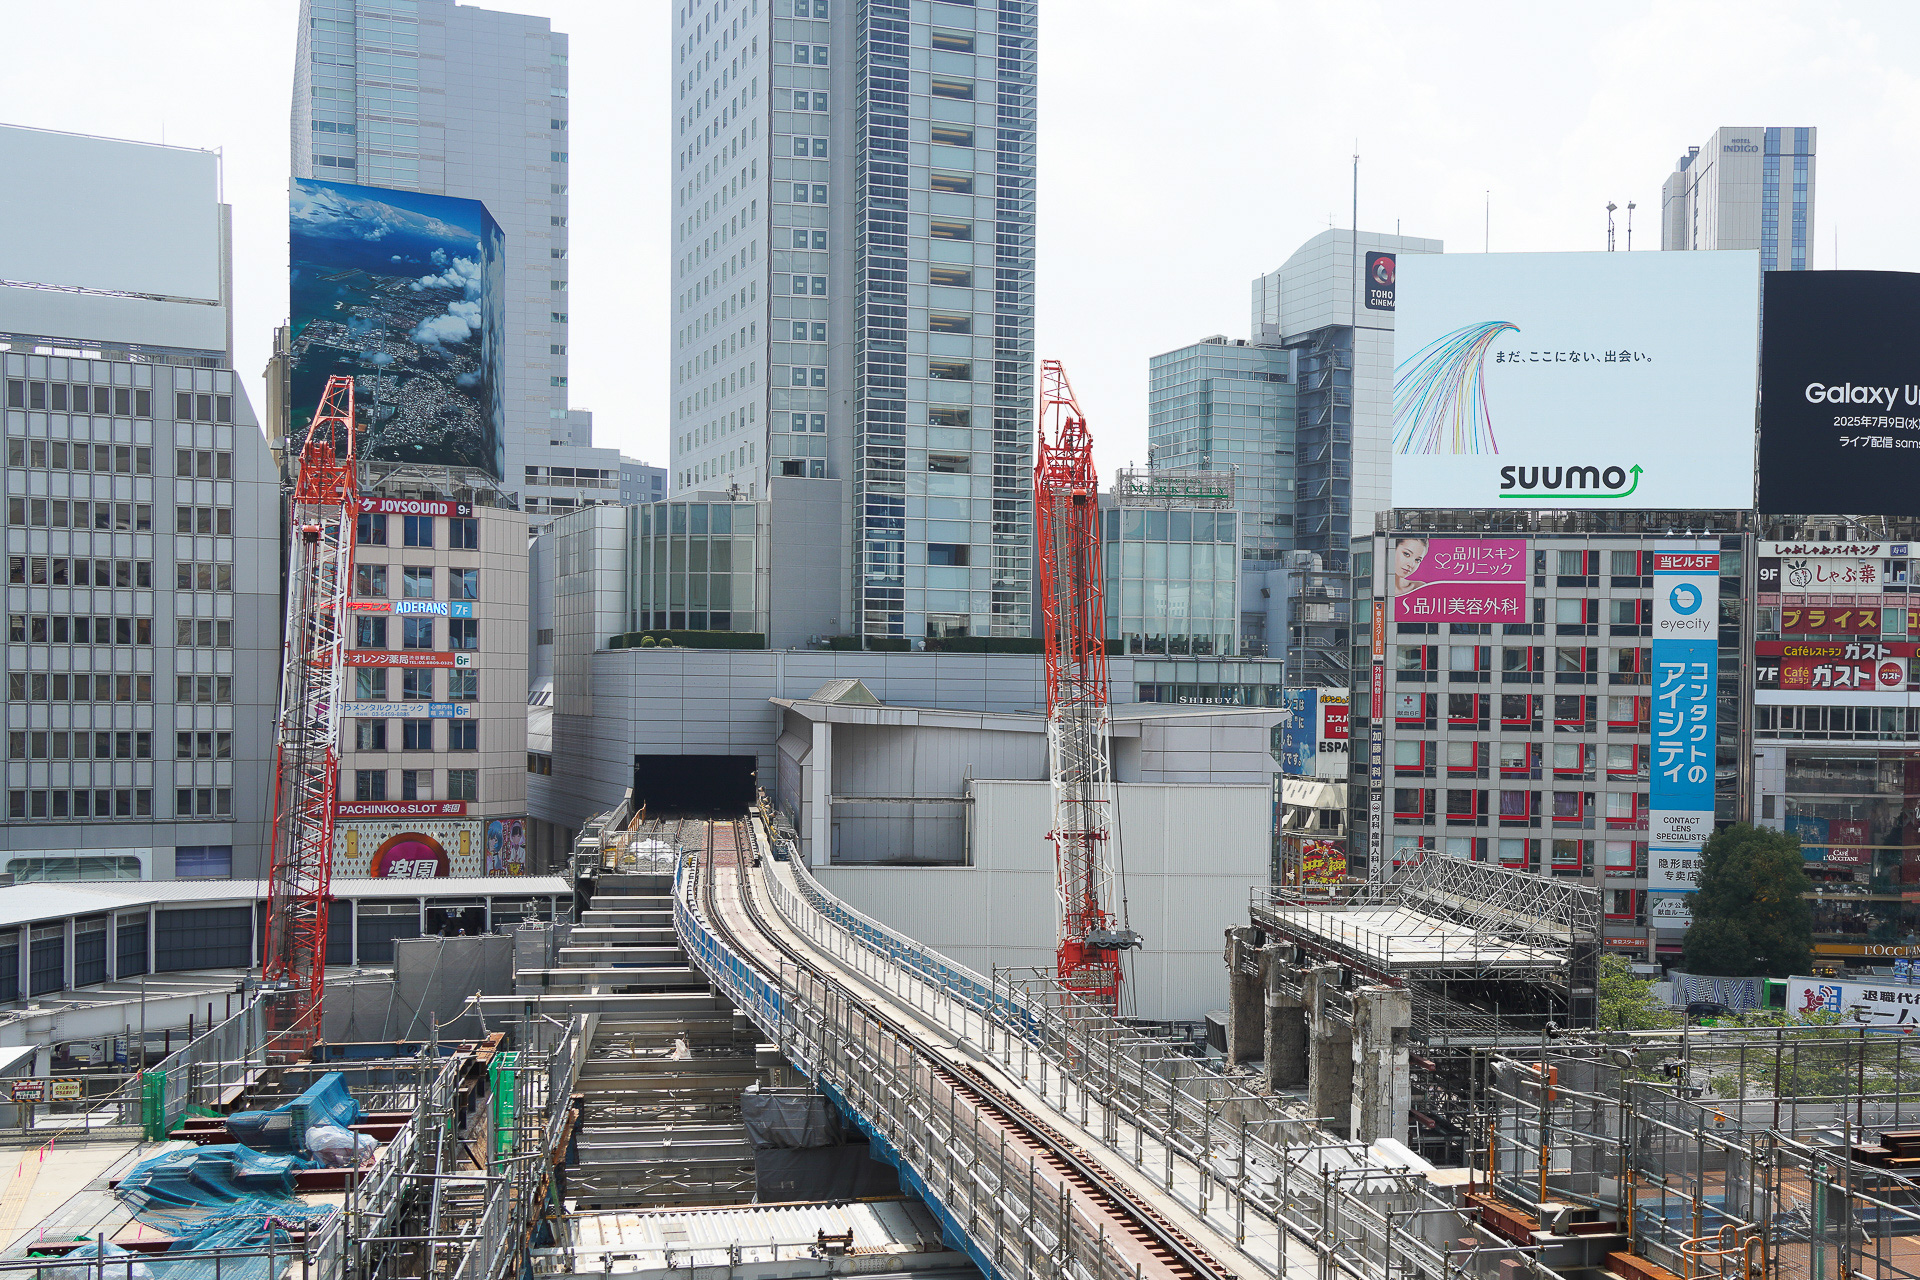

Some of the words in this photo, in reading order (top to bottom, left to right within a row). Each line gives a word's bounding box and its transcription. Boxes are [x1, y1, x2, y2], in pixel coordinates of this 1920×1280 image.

[1723, 145, 1759, 153] INDIGO
[1371, 290, 1393, 299] TOHO
[1496, 350, 1653, 363] まだ、ここにない、出会い。
[1805, 382, 1899, 411] Galaxy
[1904, 384, 1920, 405] U
[1839, 435, 1893, 448] ライブ配信
[1500, 465, 1626, 489] suumo
[1131, 485, 1179, 494] MARK
[1186, 486, 1226, 495] CITY
[380, 500, 448, 515] JOYSOUND
[457, 504, 470, 515] 9F
[1453, 546, 1520, 560] 品川スキン
[1774, 543, 1880, 556] しゃぶしゃぶバイキング
[1453, 562, 1512, 575] クリニック
[1660, 556, 1713, 568] 当ビル5F
[1759, 568, 1779, 581] 9F
[1816, 564, 1876, 584] しゃぶ葉
[395, 601, 448, 616] ADERANS
[455, 604, 469, 615] 7F
[1413, 597, 1519, 616] 品川美容外科
[1660, 618, 1711, 632] eyecity
[1782, 609, 1877, 629] プライス
[1907, 611, 1920, 628] コ
[1844, 642, 1891, 661] ガスト
[352, 653, 409, 664] オレンジ薬局
[456, 655, 470, 666] 6F
[1756, 667, 1779, 681] 7F
[1783, 666, 1809, 678] Café
[1812, 664, 1871, 687] ガスト
[1881, 672, 1901, 680] ガスト
[1784, 677, 1809, 685] レストラン
[1179, 695, 1240, 704] SHIBUYA
[455, 705, 469, 716] 6F
[1658, 662, 1686, 783] アイシティ
[1687, 662, 1709, 784] コンタクトの
[1371, 731, 1382, 778] 加藤眼科
[1371, 779, 1381, 787] 5F
[442, 803, 461, 813] 楽園
[1371, 813, 1380, 829] 内科
[1663, 816, 1701, 824] CONTACT
[1656, 832, 1707, 841] SPECIALISTS
[1371, 832, 1380, 863] 産婦人科
[387, 858, 439, 878] 楽園
[1664, 871, 1698, 882] 专卖店
